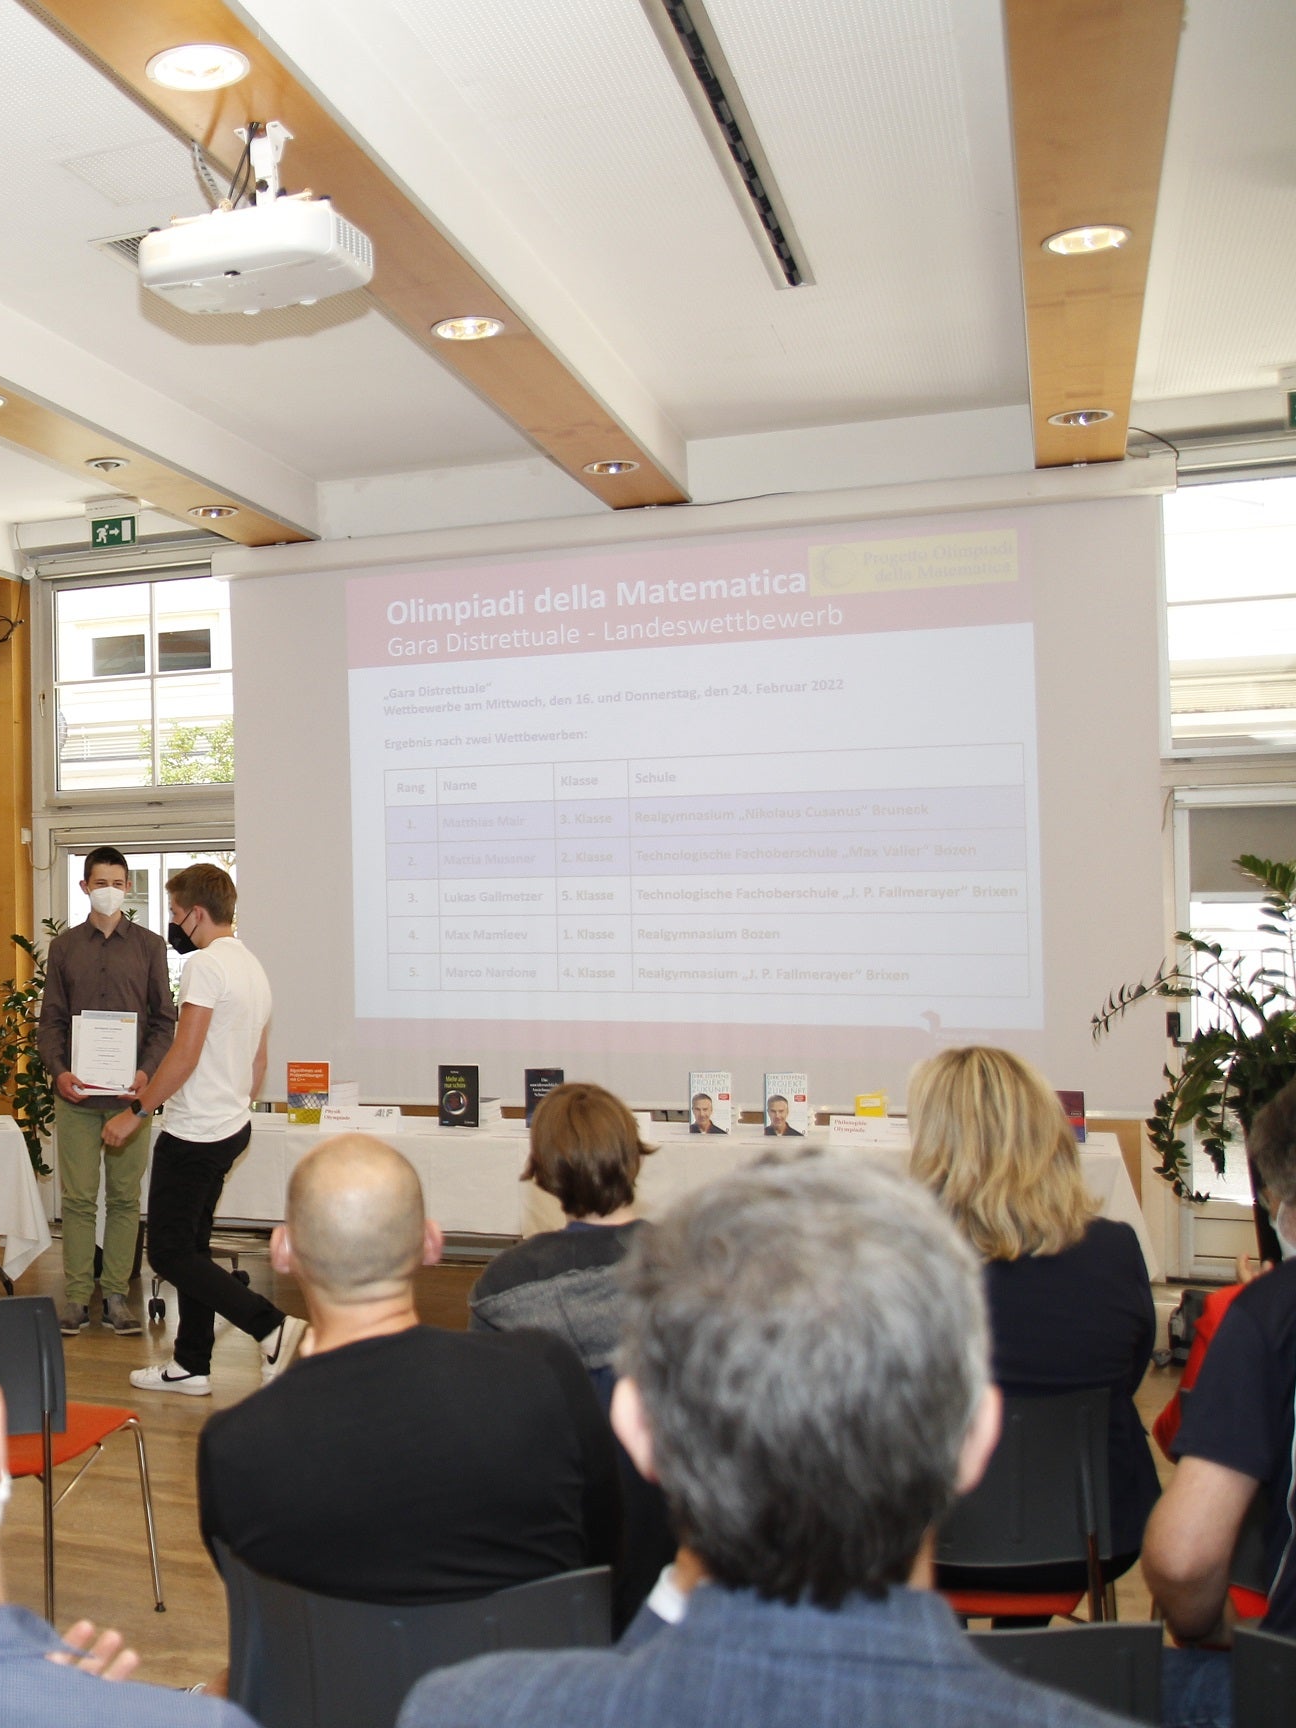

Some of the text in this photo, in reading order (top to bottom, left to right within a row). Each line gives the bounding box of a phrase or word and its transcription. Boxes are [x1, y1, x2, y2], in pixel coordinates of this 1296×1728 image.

[863, 540, 1013, 566] Progetto Olimpiadi
[874, 559, 1011, 584] della Matematica
[386, 567, 807, 627] Olimpiadi della Matematica
[386, 635, 439, 658] Gara
[446, 624, 580, 654] Distrettuale
[603, 603, 843, 642] Landeswettbewerb
[383, 686, 415, 700] „Gara
[383, 678, 844, 716] Wettbewerbe am Mittwoch, den 16. und Donnerstag, den 24. Februar 2022
[383, 728, 588, 751] Ergebnis nach zwei Wettbewerben:
[396, 772, 676, 795] Rang Name Klasse Schule
[443, 816, 494, 828] Matthias
[560, 814, 572, 825] 3.
[574, 813, 613, 825] Klasse
[635, 806, 735, 824] Realgymnasium
[738, 806, 802, 822] „Nikolaus
[871, 803, 929, 816] Bruneck
[406, 855, 416, 866] 2.
[443, 853, 482, 865] Mattia
[561, 853, 573, 863] 2.
[575, 851, 614, 863] Klasse
[636, 847, 732, 864] Technologische
[735, 845, 838, 860] Fachoberschule
[841, 844, 879, 860] „Max
[934, 843, 977, 856] Bozen
[407, 892, 419, 903] 3.
[444, 890, 477, 903] Lukas
[480, 890, 544, 903] Gallmetzer
[561, 889, 573, 901] 5.
[575, 889, 614, 901] Klasse
[636, 887, 733, 903] Technologische
[736, 886, 839, 900] Fachoberschule
[863, 885, 875, 898] P.
[972, 885, 1018, 899] Brixen
[407, 929, 419, 941] 4.
[444, 929, 471, 940] Max
[563, 929, 574, 940] 1.
[576, 928, 615, 940] Klasse
[637, 927, 737, 944] Realgymnasium
[741, 928, 780, 940] Bozen
[408, 966, 419, 978] 5.
[445, 966, 482, 978] Marco
[484, 966, 536, 978] Nardone
[562, 967, 575, 978] 4.
[577, 966, 616, 978] Klasse
[638, 966, 738, 984] Realgymnasium
[762, 967, 773, 980] P.
[866, 967, 910, 980] Brixen
